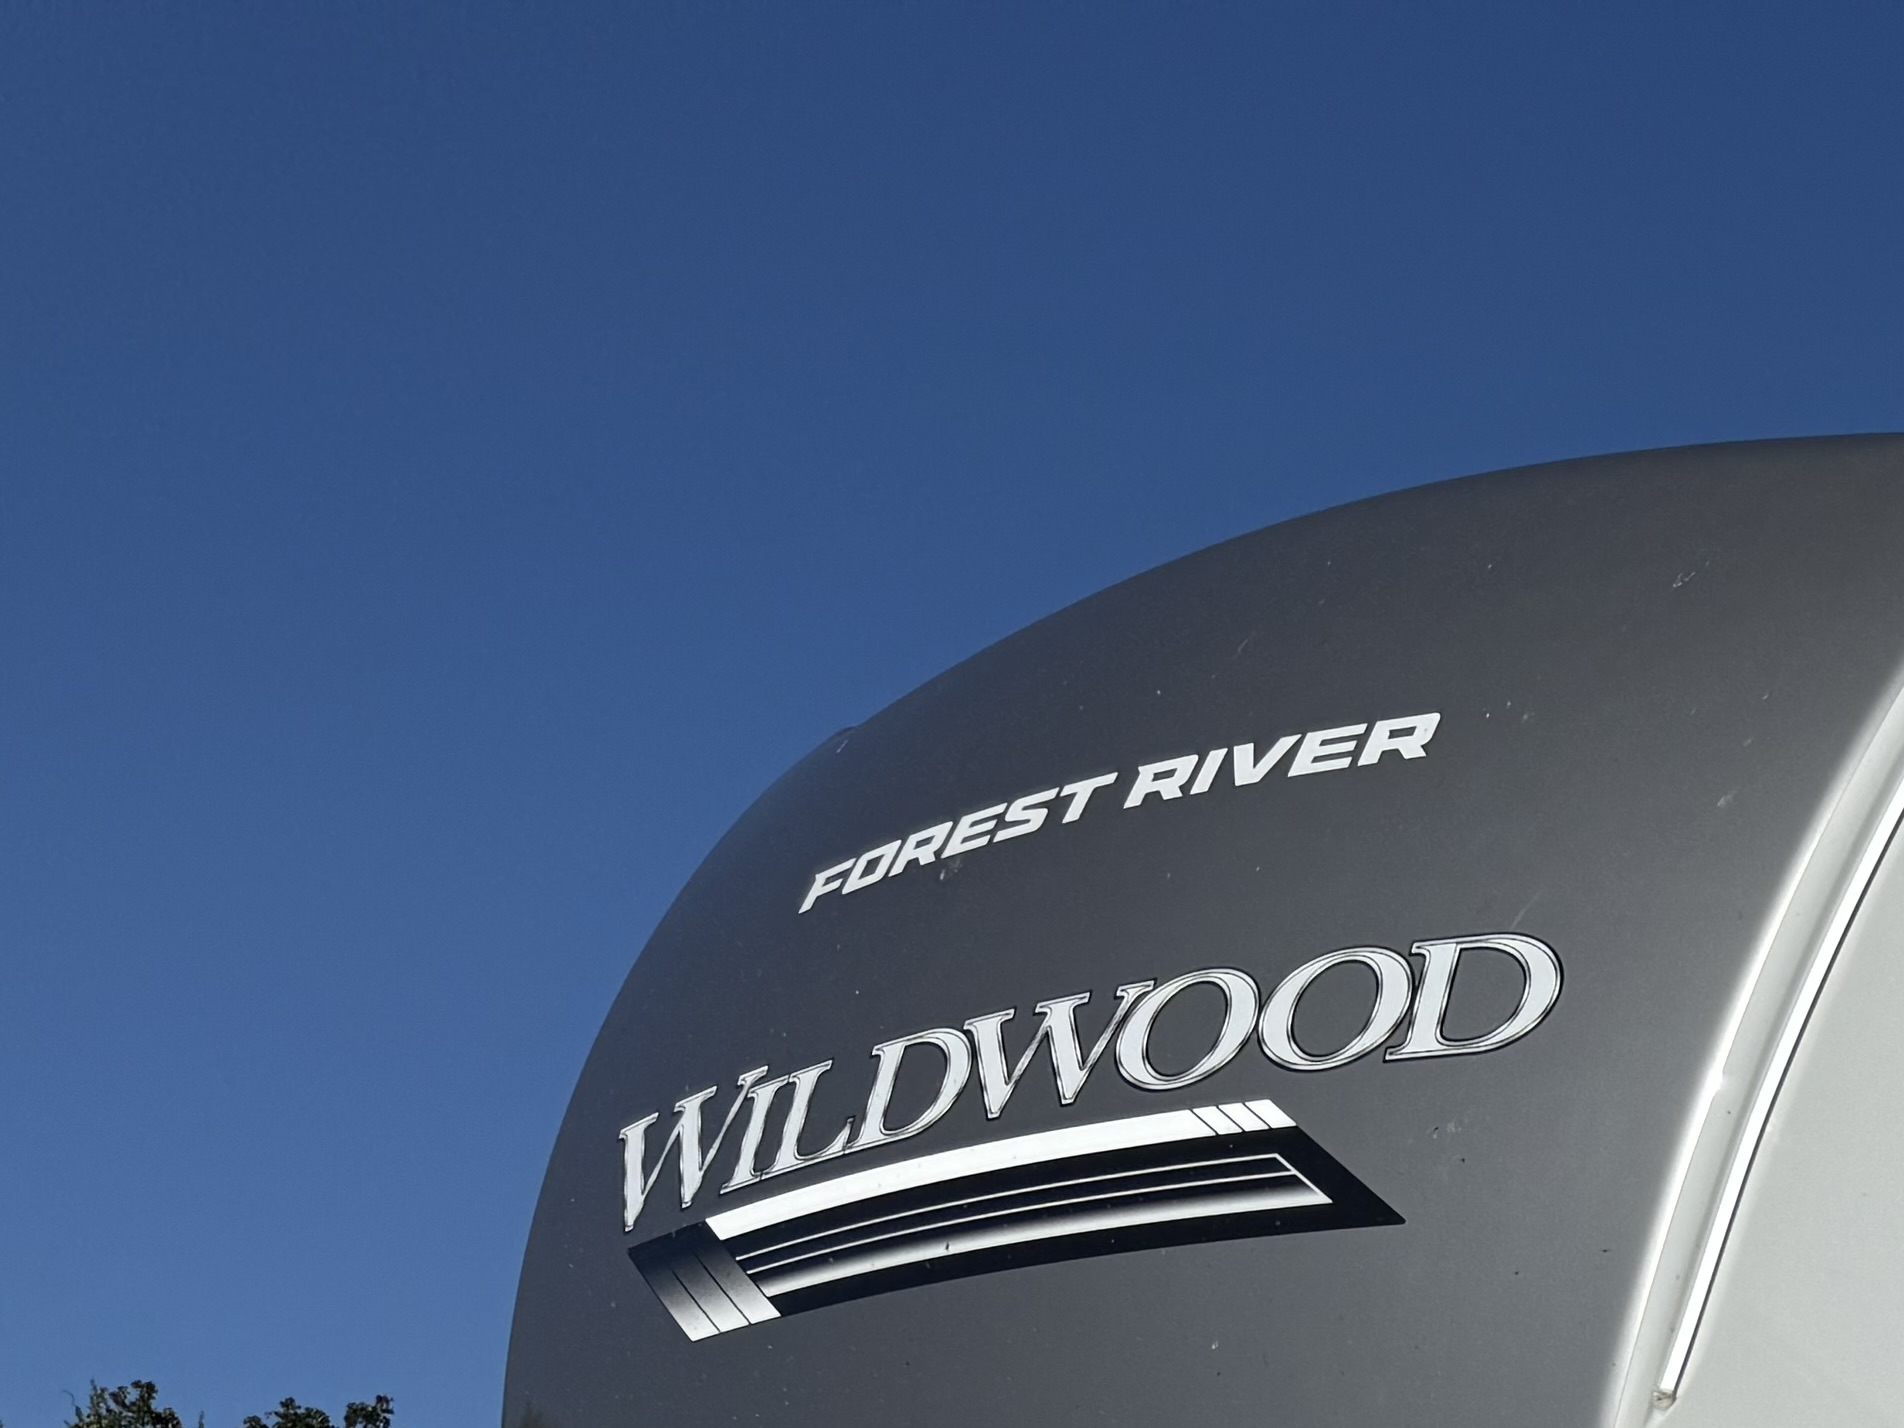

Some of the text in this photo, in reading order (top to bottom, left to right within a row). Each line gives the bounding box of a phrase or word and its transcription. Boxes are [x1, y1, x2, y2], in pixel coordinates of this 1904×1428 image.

[799, 712, 1440, 913] FOREST RIVER
[618, 932, 1563, 1232] WILDWOOD
